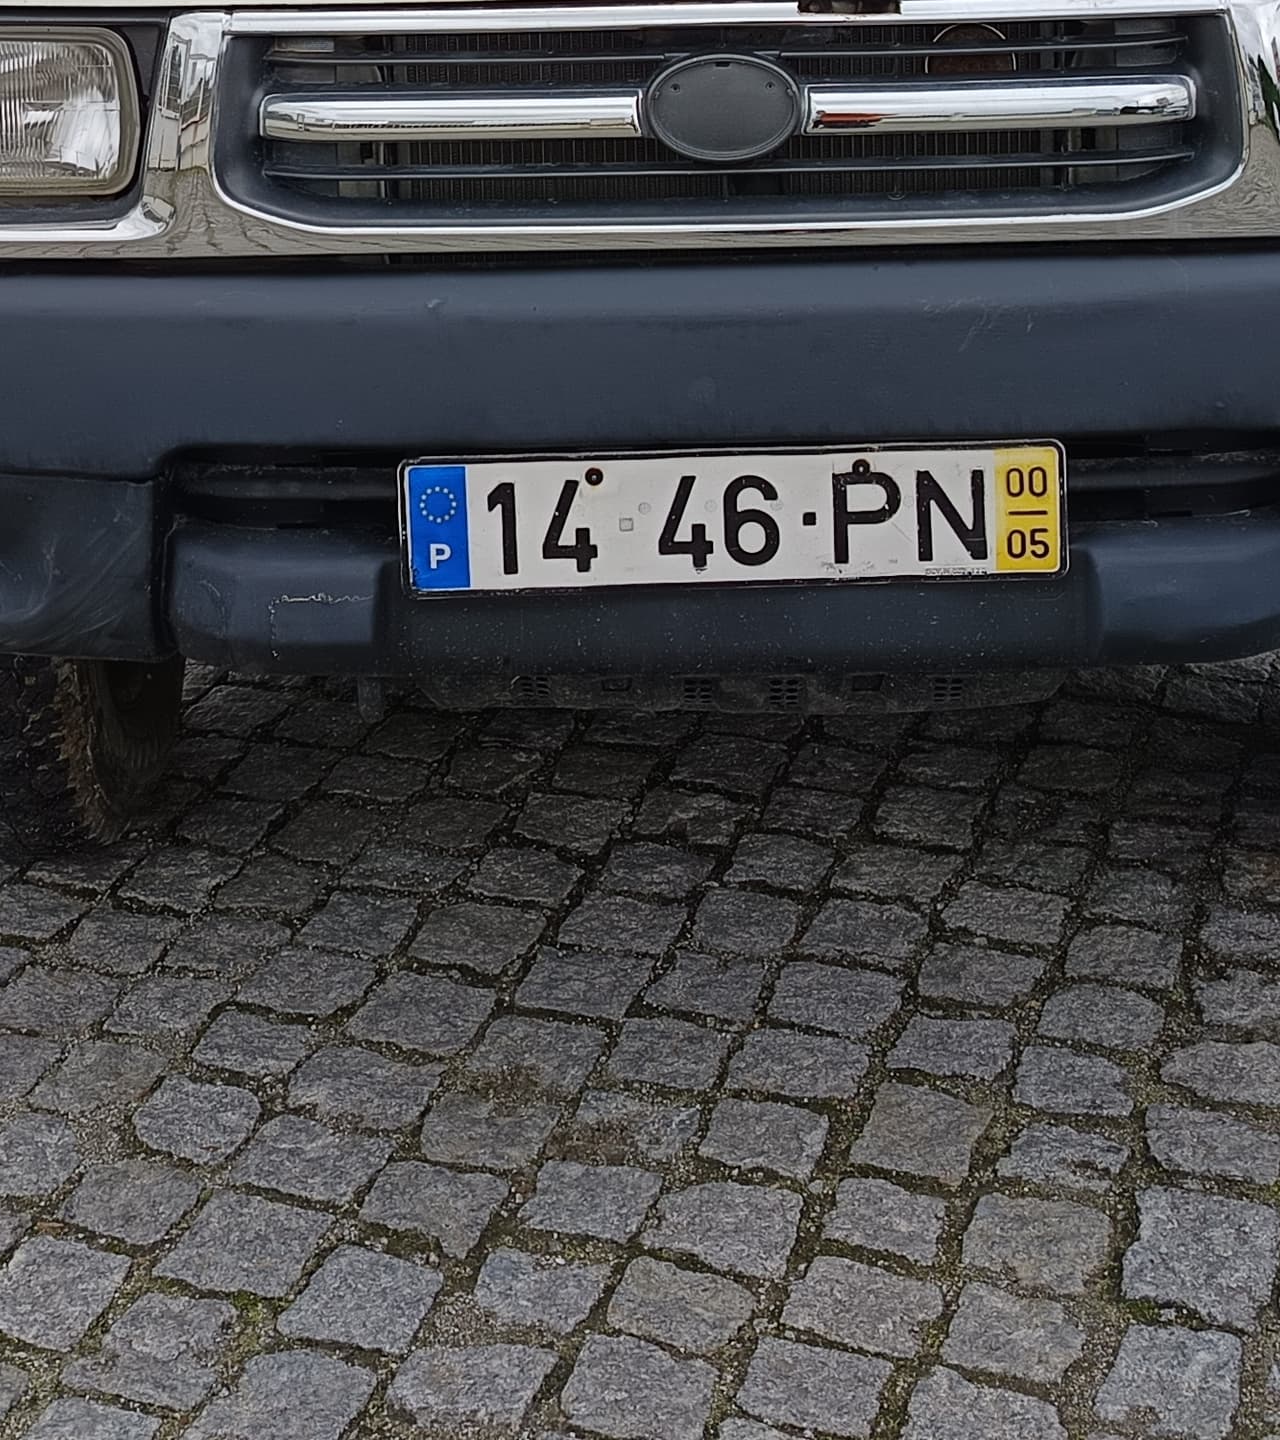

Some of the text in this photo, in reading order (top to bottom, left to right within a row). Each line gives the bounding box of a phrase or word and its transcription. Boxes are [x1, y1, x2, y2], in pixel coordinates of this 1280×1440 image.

[1004, 466, 1049, 499] 00
[428, 543, 453, 570] P
[1005, 527, 1050, 560] 05
